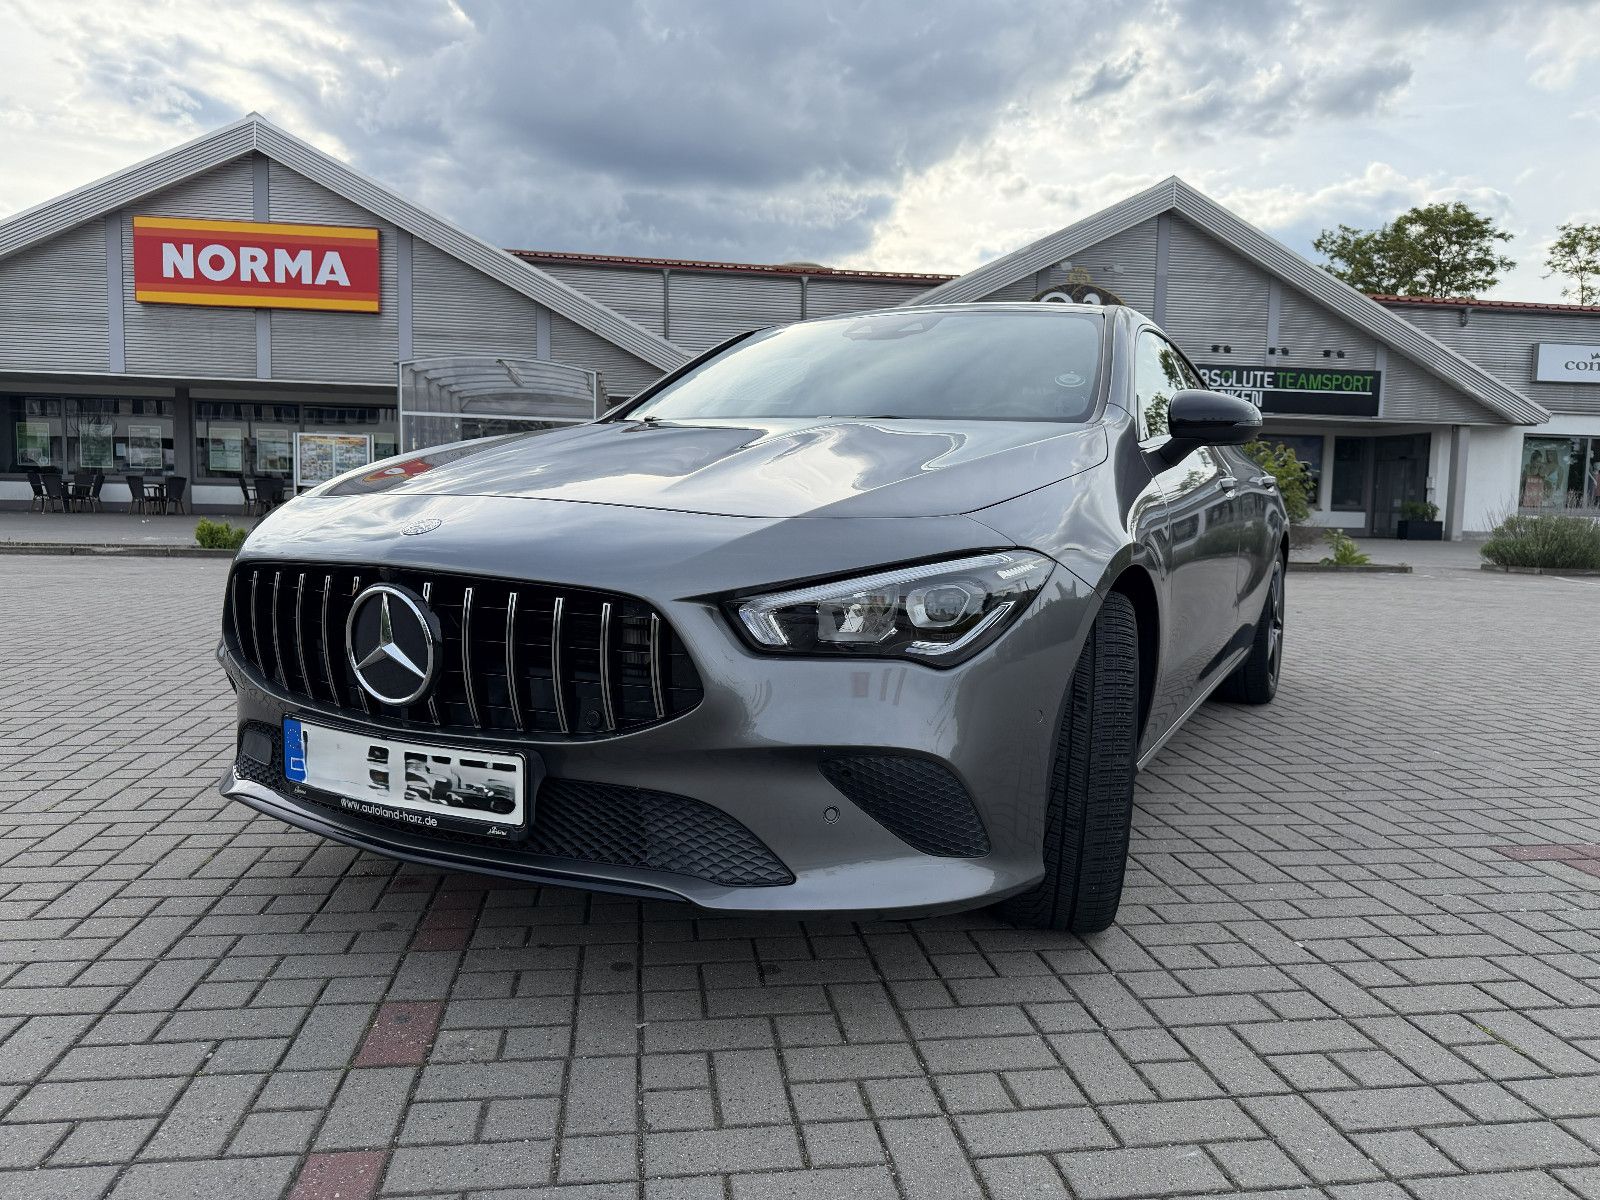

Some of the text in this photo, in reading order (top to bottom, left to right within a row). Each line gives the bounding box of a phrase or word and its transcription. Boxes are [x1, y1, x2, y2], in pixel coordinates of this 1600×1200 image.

[162, 242, 351, 287] NORMA
[1199, 368, 1374, 392] BSOLUTE TEAMSPORT
[340, 797, 438, 827] www.autoland-harz.de
